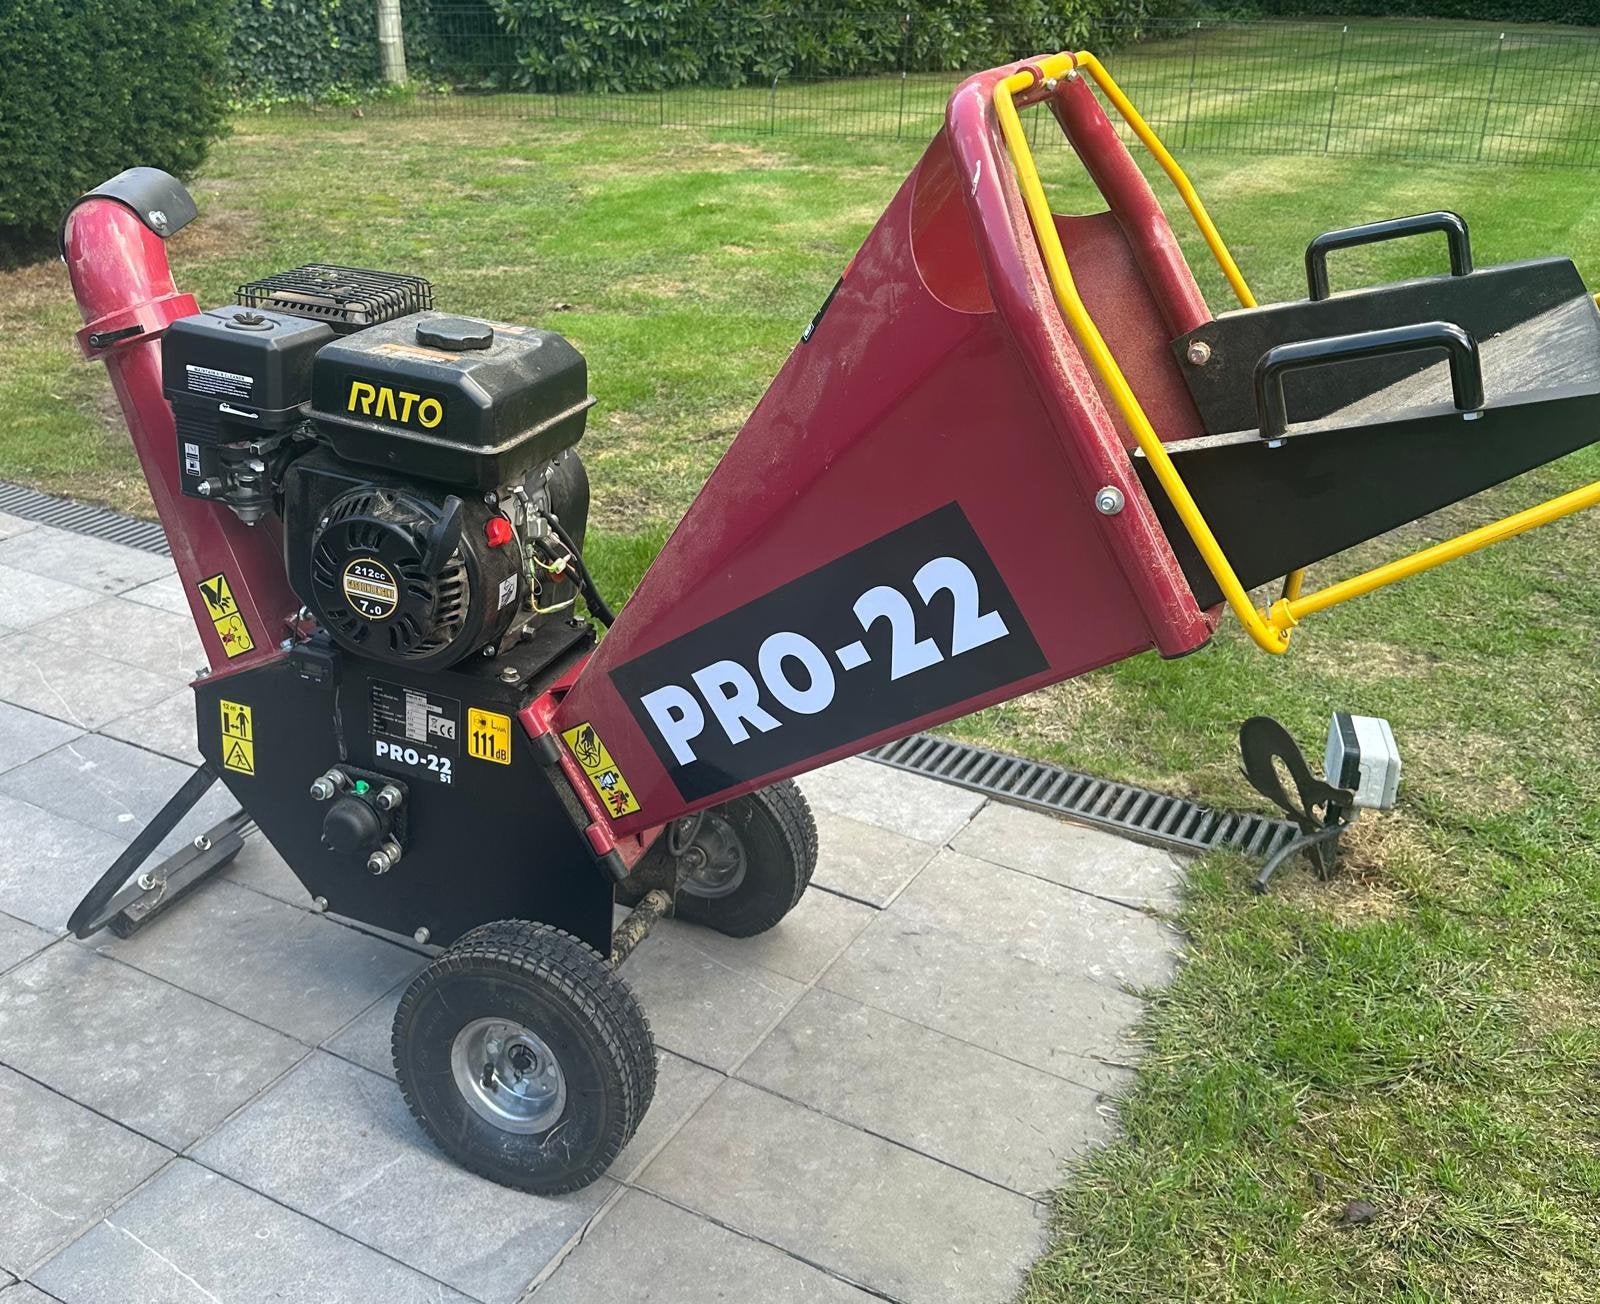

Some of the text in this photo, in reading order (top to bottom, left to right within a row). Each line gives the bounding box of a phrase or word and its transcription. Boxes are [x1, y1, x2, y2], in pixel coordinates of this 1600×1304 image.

[347, 381, 443, 429] RATO
[354, 565, 386, 580] 212cc
[360, 600, 382, 615] 7.0
[640, 556, 1010, 766] PRO-22
[375, 740, 452, 775] PRO-22
[473, 730, 507, 760] 111 dB
[440, 773, 452, 784] S1
